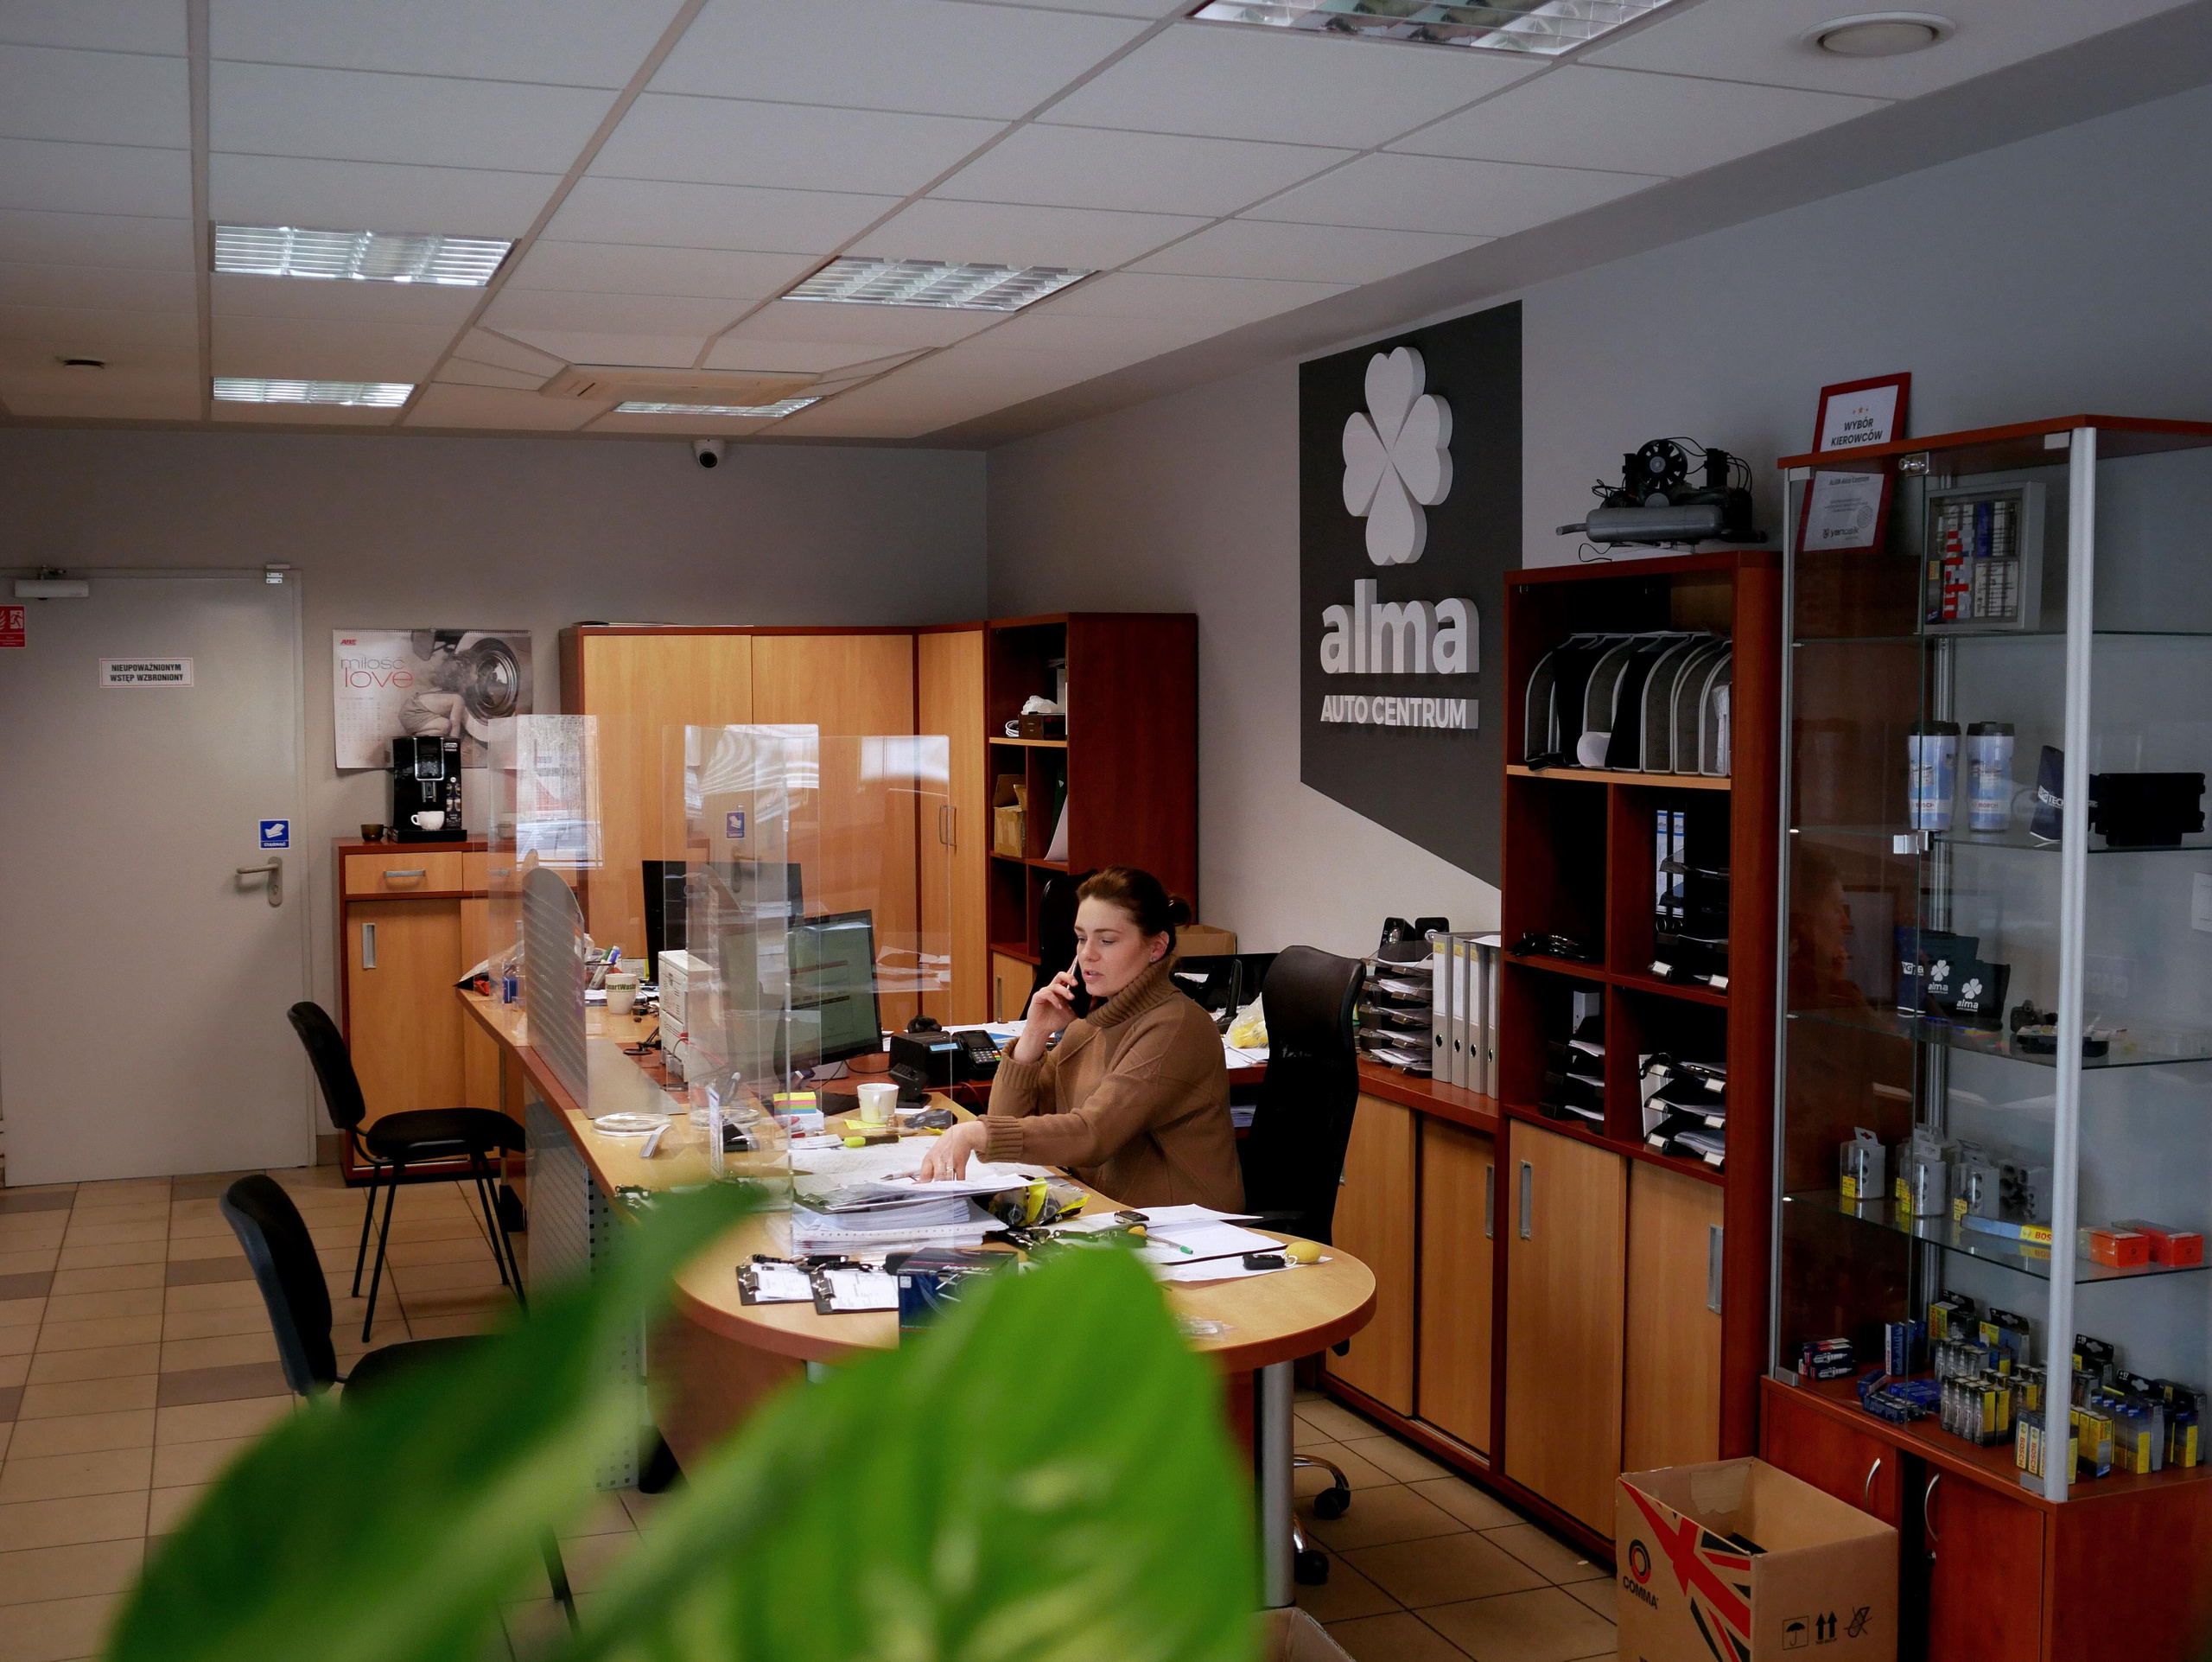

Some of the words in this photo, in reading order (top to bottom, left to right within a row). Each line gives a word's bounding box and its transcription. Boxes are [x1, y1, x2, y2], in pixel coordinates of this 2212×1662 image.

[1844, 417, 1874, 430] WYBÓR
[1831, 429, 1884, 446] KIEROWCÓW
[1320, 578, 1476, 674] alma
[111, 663, 182, 672] NIEUPOWAŻNIONYM
[340, 656, 405, 670] miłość
[110, 674, 135, 683] WSTĘP
[345, 666, 414, 688] love
[1320, 695, 1369, 724] AUTO
[1371, 696, 1468, 729] CENTRUM
[2049, 794, 2064, 807] TEC
[1928, 981, 1948, 991] alma
[1956, 998, 1979, 1009] alma
[1623, 1576, 1658, 1610] COMMA
